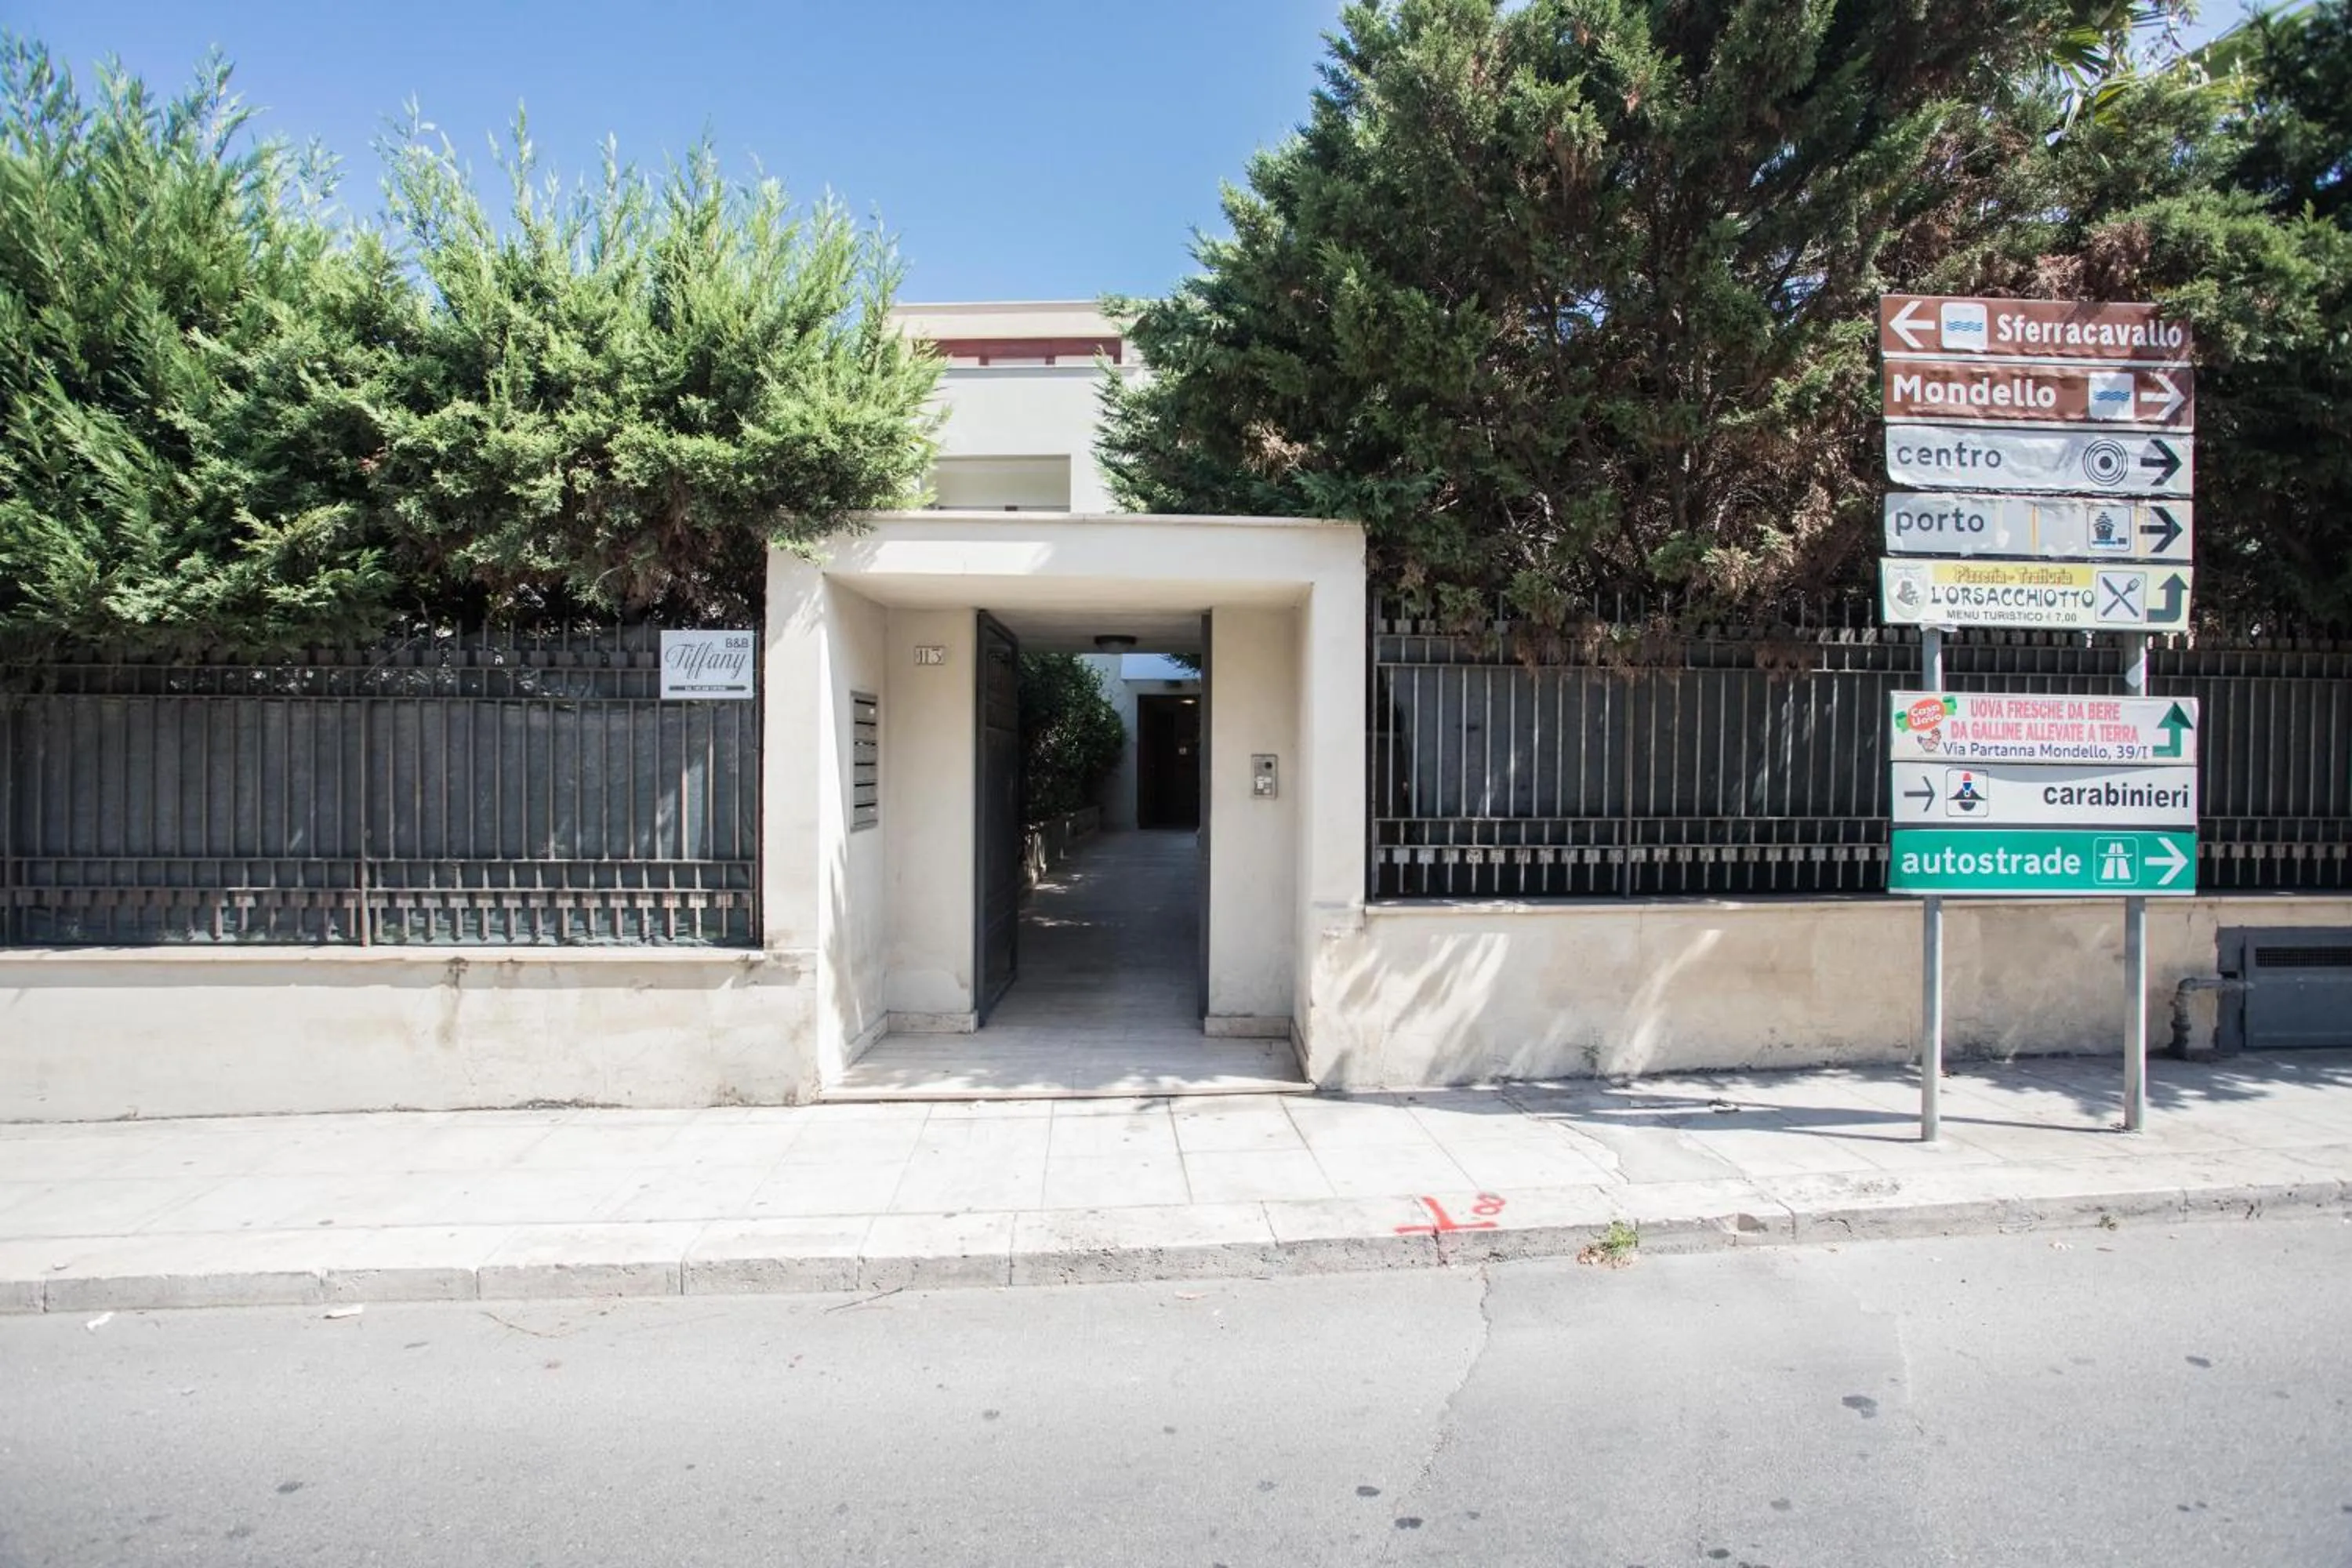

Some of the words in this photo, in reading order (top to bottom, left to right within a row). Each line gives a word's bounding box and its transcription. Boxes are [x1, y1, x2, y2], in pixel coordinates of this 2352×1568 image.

[1997, 314, 2182, 348] Sferracavallo
[1893, 374, 2056, 408] Mondello
[1896, 441, 2002, 468] centro
[1896, 507, 1984, 536] porto
[1931, 586, 2094, 608] L'ORSACCHIOTTO
[1947, 610, 1979, 620] MENU
[1984, 611, 2042, 622] TURISTICO
[2056, 612, 2077, 624] 7,00
[726, 638, 749, 648] B&B
[665, 641, 746, 679] Tiffany
[1970, 699, 2003, 717] UOVA
[2006, 700, 2063, 719] FRESCHE
[2067, 702, 2084, 720] DA
[2088, 702, 2121, 720] BERE
[1951, 721, 1968, 739] DA
[1971, 722, 2021, 740] GALLINE
[2025, 723, 2084, 742] ALLEVATE
[2088, 724, 2096, 742] A
[2099, 724, 2140, 743] TERRA
[1943, 742, 1965, 755] Via
[1970, 742, 2035, 757] Partanna
[2040, 743, 2111, 760] Mondello,
[2043, 782, 2189, 808] carabinieri
[1901, 847, 2081, 875] autostrade
